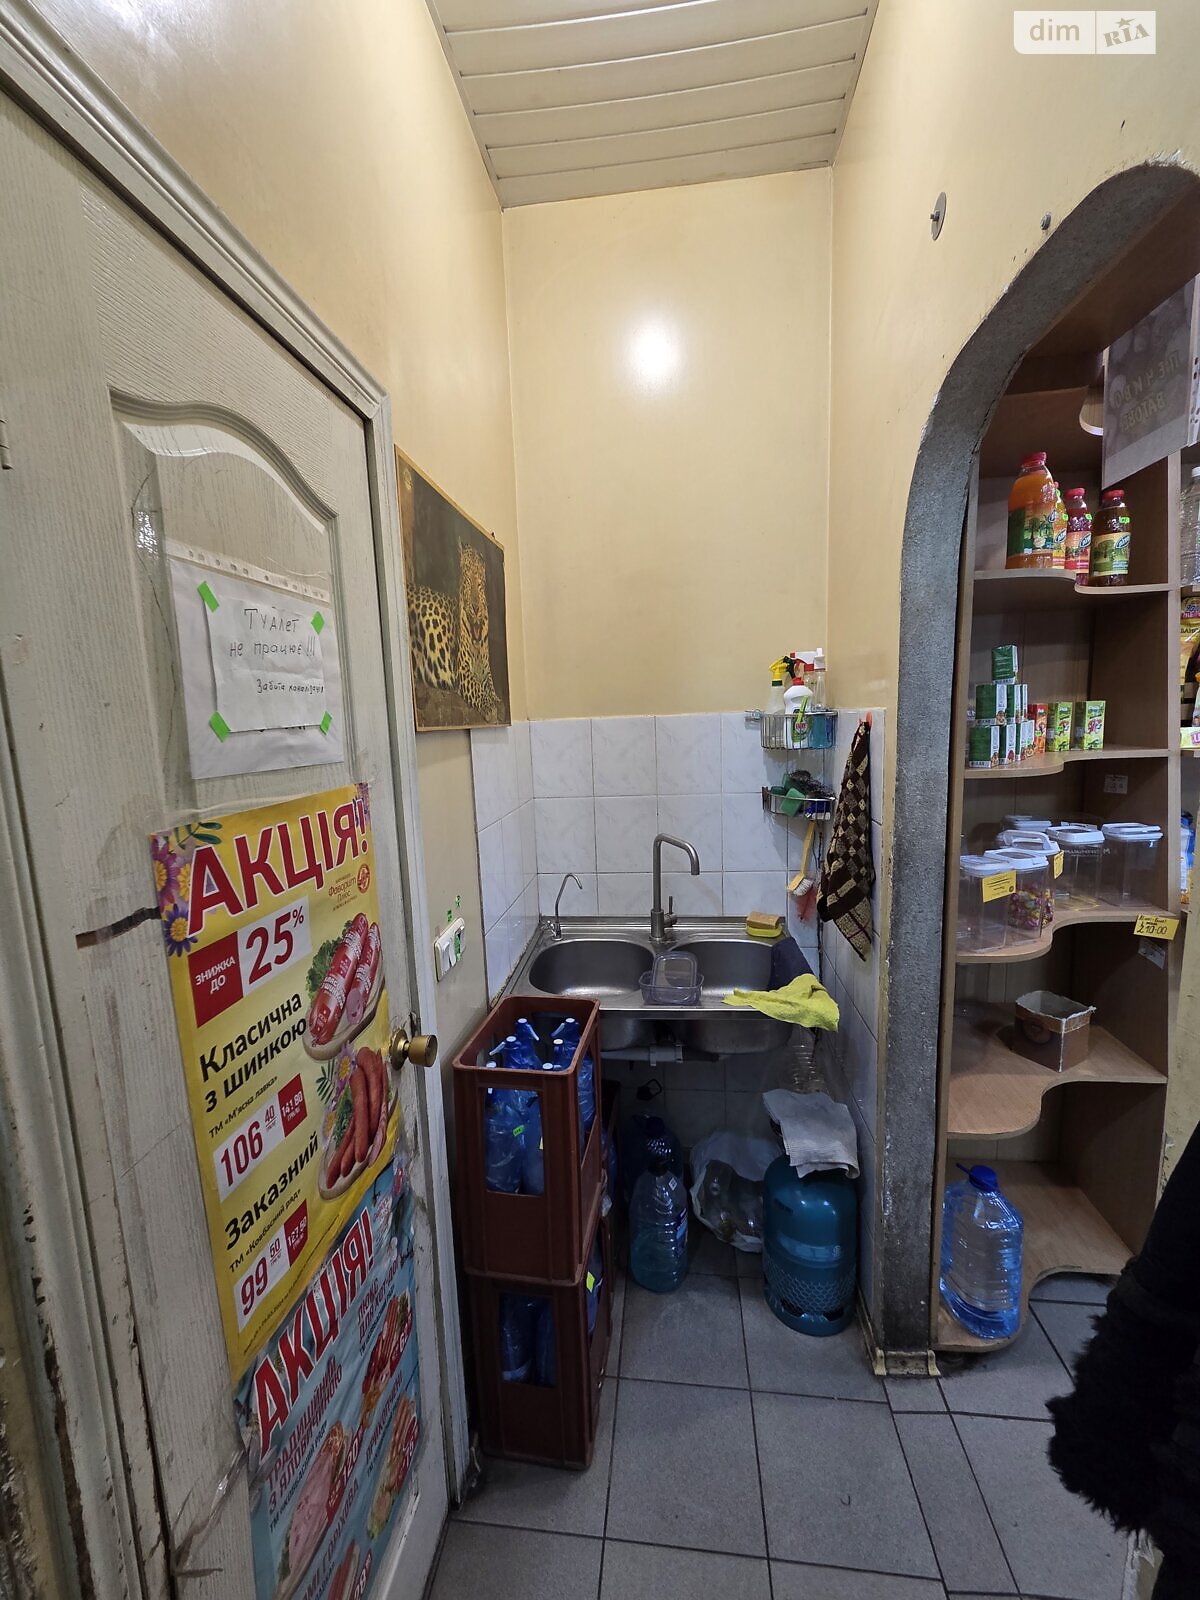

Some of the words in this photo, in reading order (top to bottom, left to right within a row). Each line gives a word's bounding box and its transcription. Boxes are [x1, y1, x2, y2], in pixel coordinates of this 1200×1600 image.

[186, 799, 369, 939] АКЦІЯ!
[195, 955, 236, 986] ЗНИЖКА
[210, 975, 227, 995] ДО
[199, 993, 302, 1083] Класична
[223, 1017, 307, 1099] шинкою
[208, 1122, 223, 1138] ТМ
[220, 1120, 264, 1188] 106
[224, 1130, 319, 1251] Заказний
[241, 1256, 269, 1317] 99
[255, 1207, 374, 1464] АКЦІЯ!
